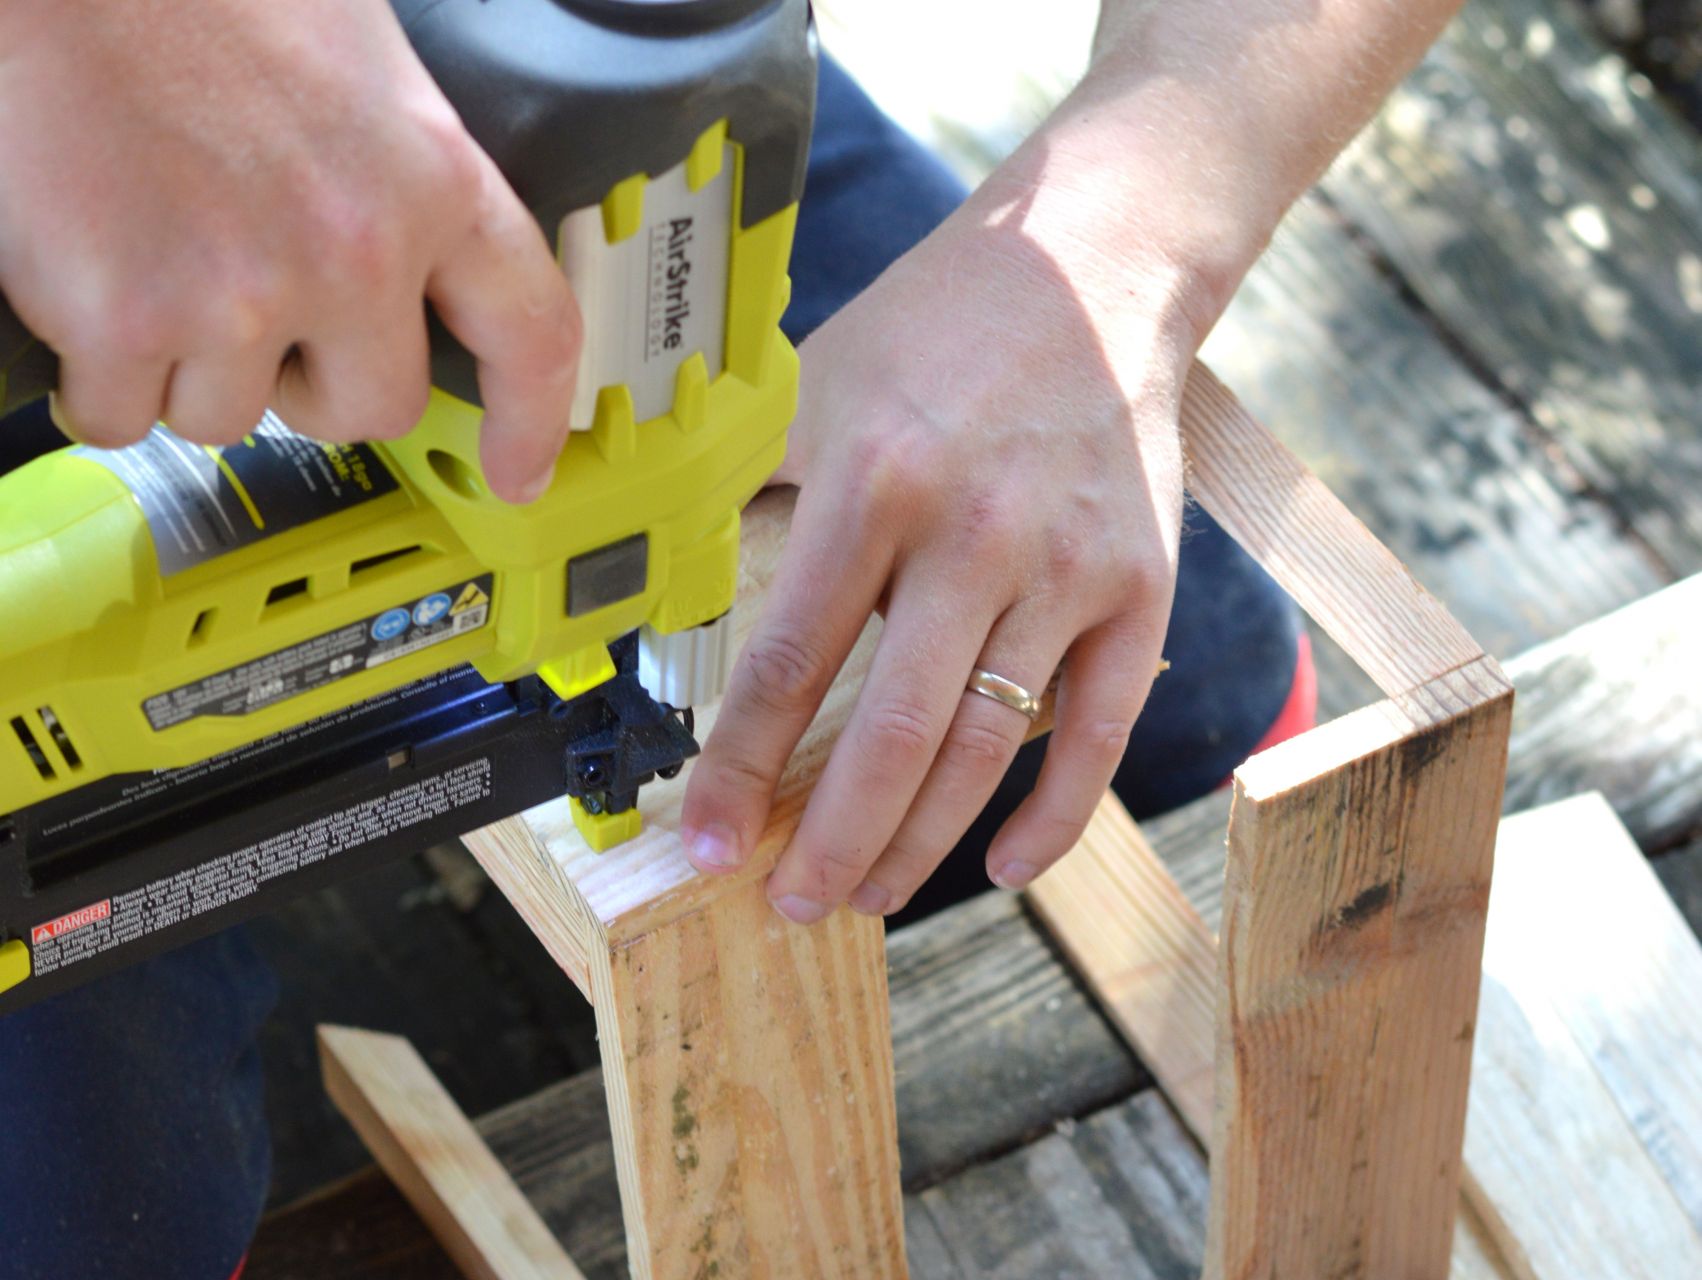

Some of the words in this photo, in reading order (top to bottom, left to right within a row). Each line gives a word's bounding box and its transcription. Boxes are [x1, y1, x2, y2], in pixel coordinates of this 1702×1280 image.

[650, 222, 669, 358] TECHNOLOGY
[663, 217, 694, 350] AirStrike
[54, 903, 107, 935] DANGER
